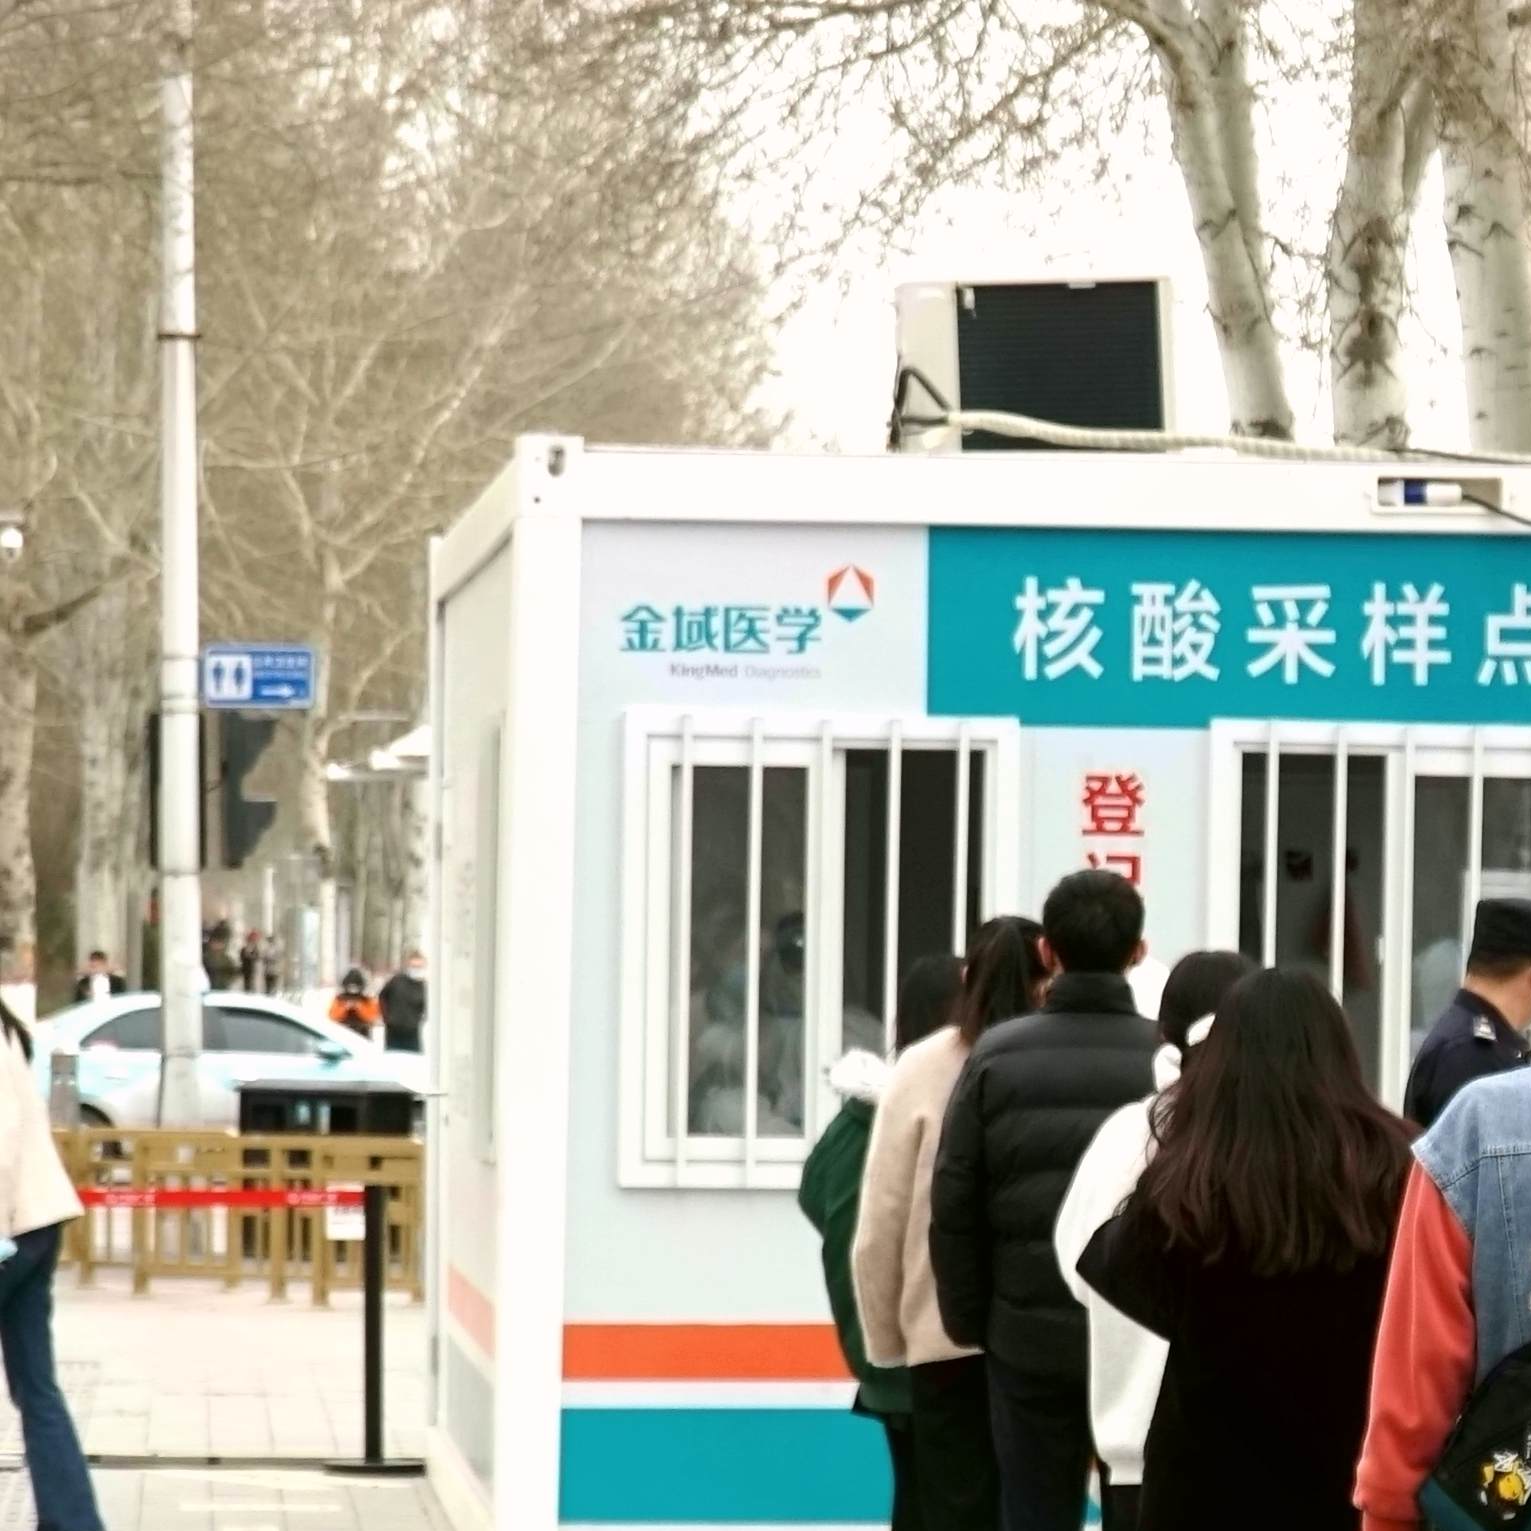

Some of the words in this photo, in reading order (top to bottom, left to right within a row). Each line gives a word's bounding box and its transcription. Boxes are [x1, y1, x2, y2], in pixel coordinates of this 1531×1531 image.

[619, 604, 823, 655] 金域医学
[670, 663, 738, 681] KingMed
